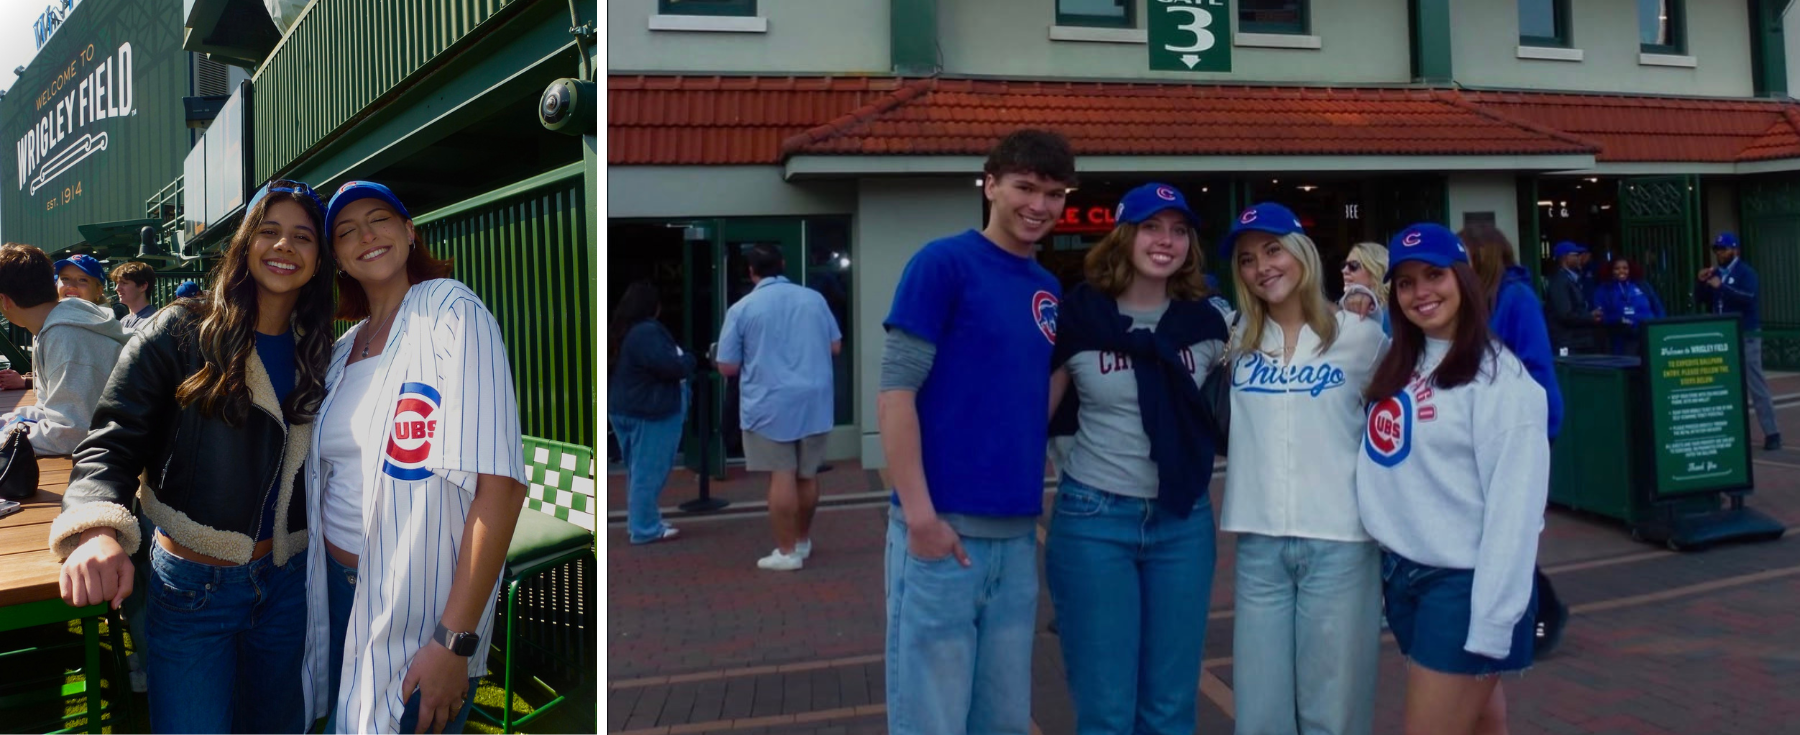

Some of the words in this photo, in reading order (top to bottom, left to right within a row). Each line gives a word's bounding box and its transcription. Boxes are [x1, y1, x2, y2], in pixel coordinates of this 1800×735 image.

[1165, 6, 1215, 52] 3
[36, 60, 76, 111] WELCOME
[81, 44, 94, 67] TO
[17, 89, 76, 191] WRIGLEY
[79, 42, 132, 127] FIELD
[46, 198, 58, 211] EST.
[61, 181, 82, 206] 1914
[1232, 352, 1346, 397] Chicago
